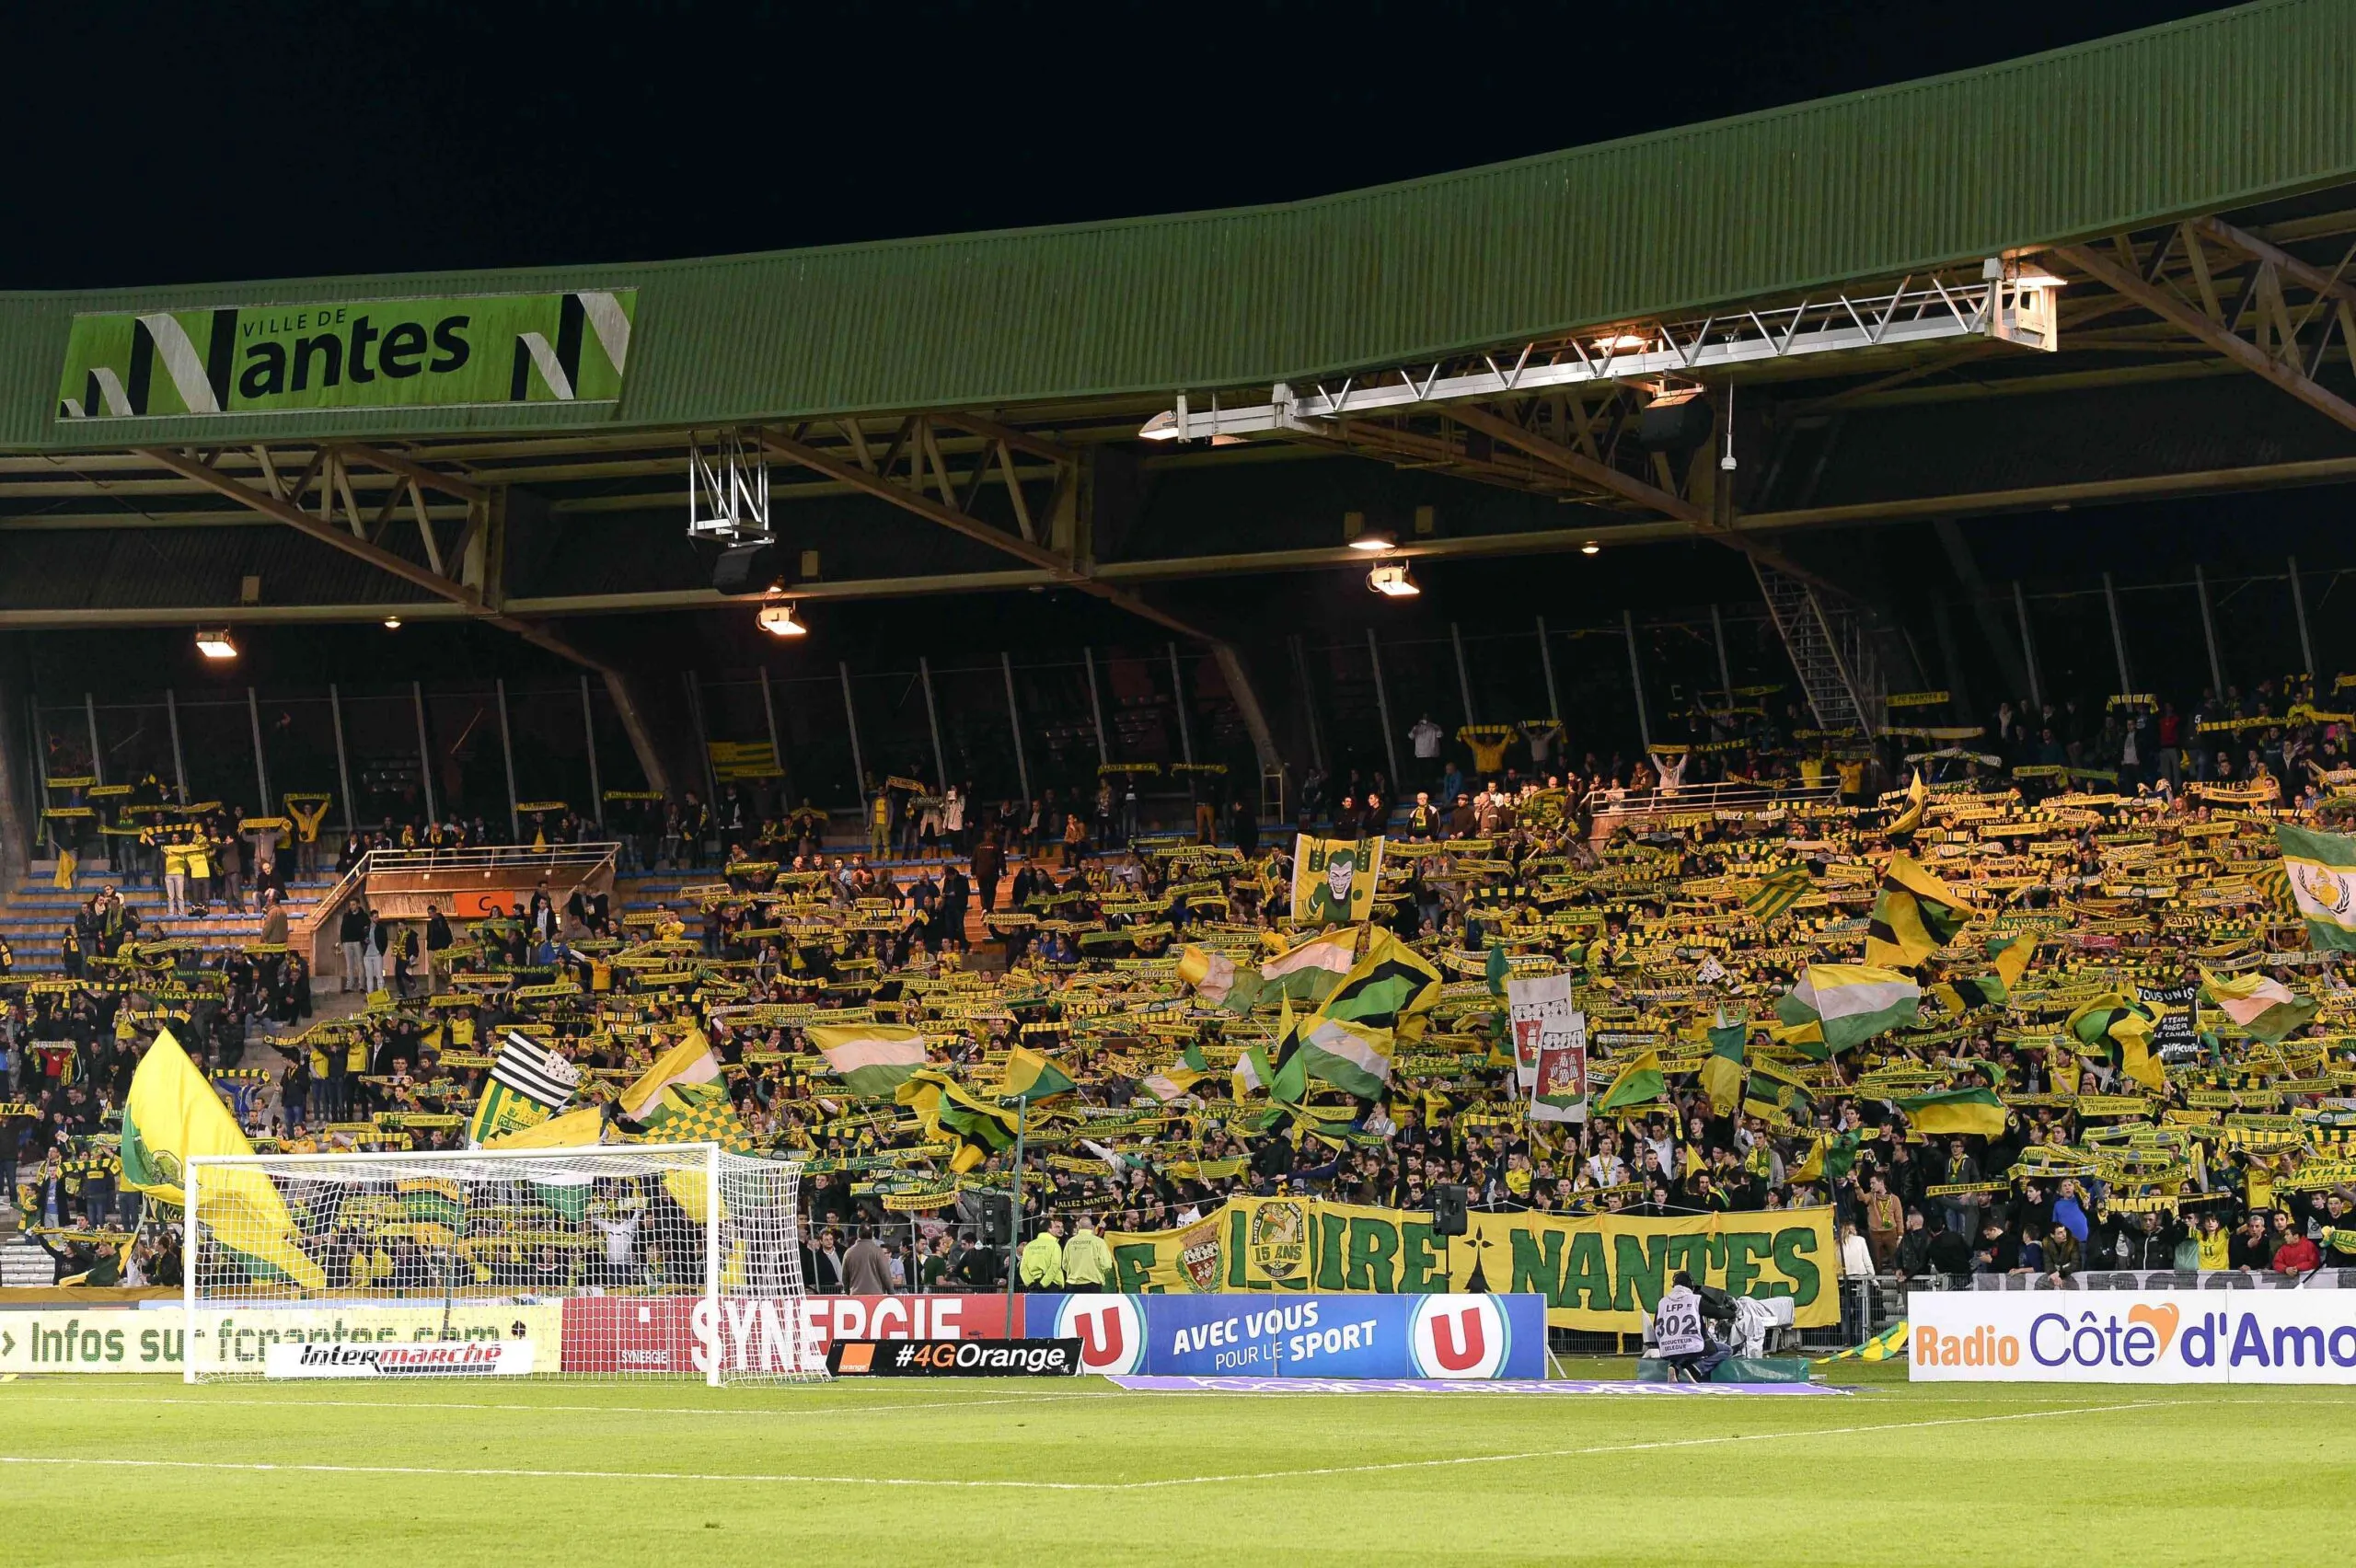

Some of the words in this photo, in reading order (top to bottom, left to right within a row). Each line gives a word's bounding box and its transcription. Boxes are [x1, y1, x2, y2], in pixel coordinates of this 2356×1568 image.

[243, 314, 307, 338] VILLE
[318, 308, 346, 328] DE
[1717, 811, 1743, 819] ALLEZ
[1756, 809, 1784, 819] NANTES
[478, 896, 491, 911] C
[2137, 988, 2164, 1001] TOUS
[2165, 987, 2195, 1001] UNIS
[1718, 1104, 1728, 1113] FC
[1083, 1195, 1114, 1205] NANTES
[1255, 1247, 1270, 1262] 15
[1276, 1246, 1302, 1260] ANS
[1510, 1227, 1819, 1313] NANTES
[1667, 1304, 1683, 1312] LFP
[692, 1297, 962, 1373] SYNERGIE
[1075, 1307, 1124, 1366] U
[1173, 1318, 1239, 1355] AVEC
[1243, 1300, 1319, 1345] VOUS
[1657, 1315, 1698, 1337] 302
[1916, 1325, 2020, 1366] Radio
[2029, 1310, 2155, 1366] Côte
[32, 1320, 124, 1362] Infos
[1216, 1349, 1265, 1371] POUR
[1269, 1343, 1284, 1361] LE
[1289, 1319, 1378, 1362] SPORT
[1432, 1307, 1485, 1371] U
[622, 1350, 667, 1366] SYNERGIE
[840, 1364, 869, 1372] orange
[896, 1343, 1066, 1371] #4GOrange
